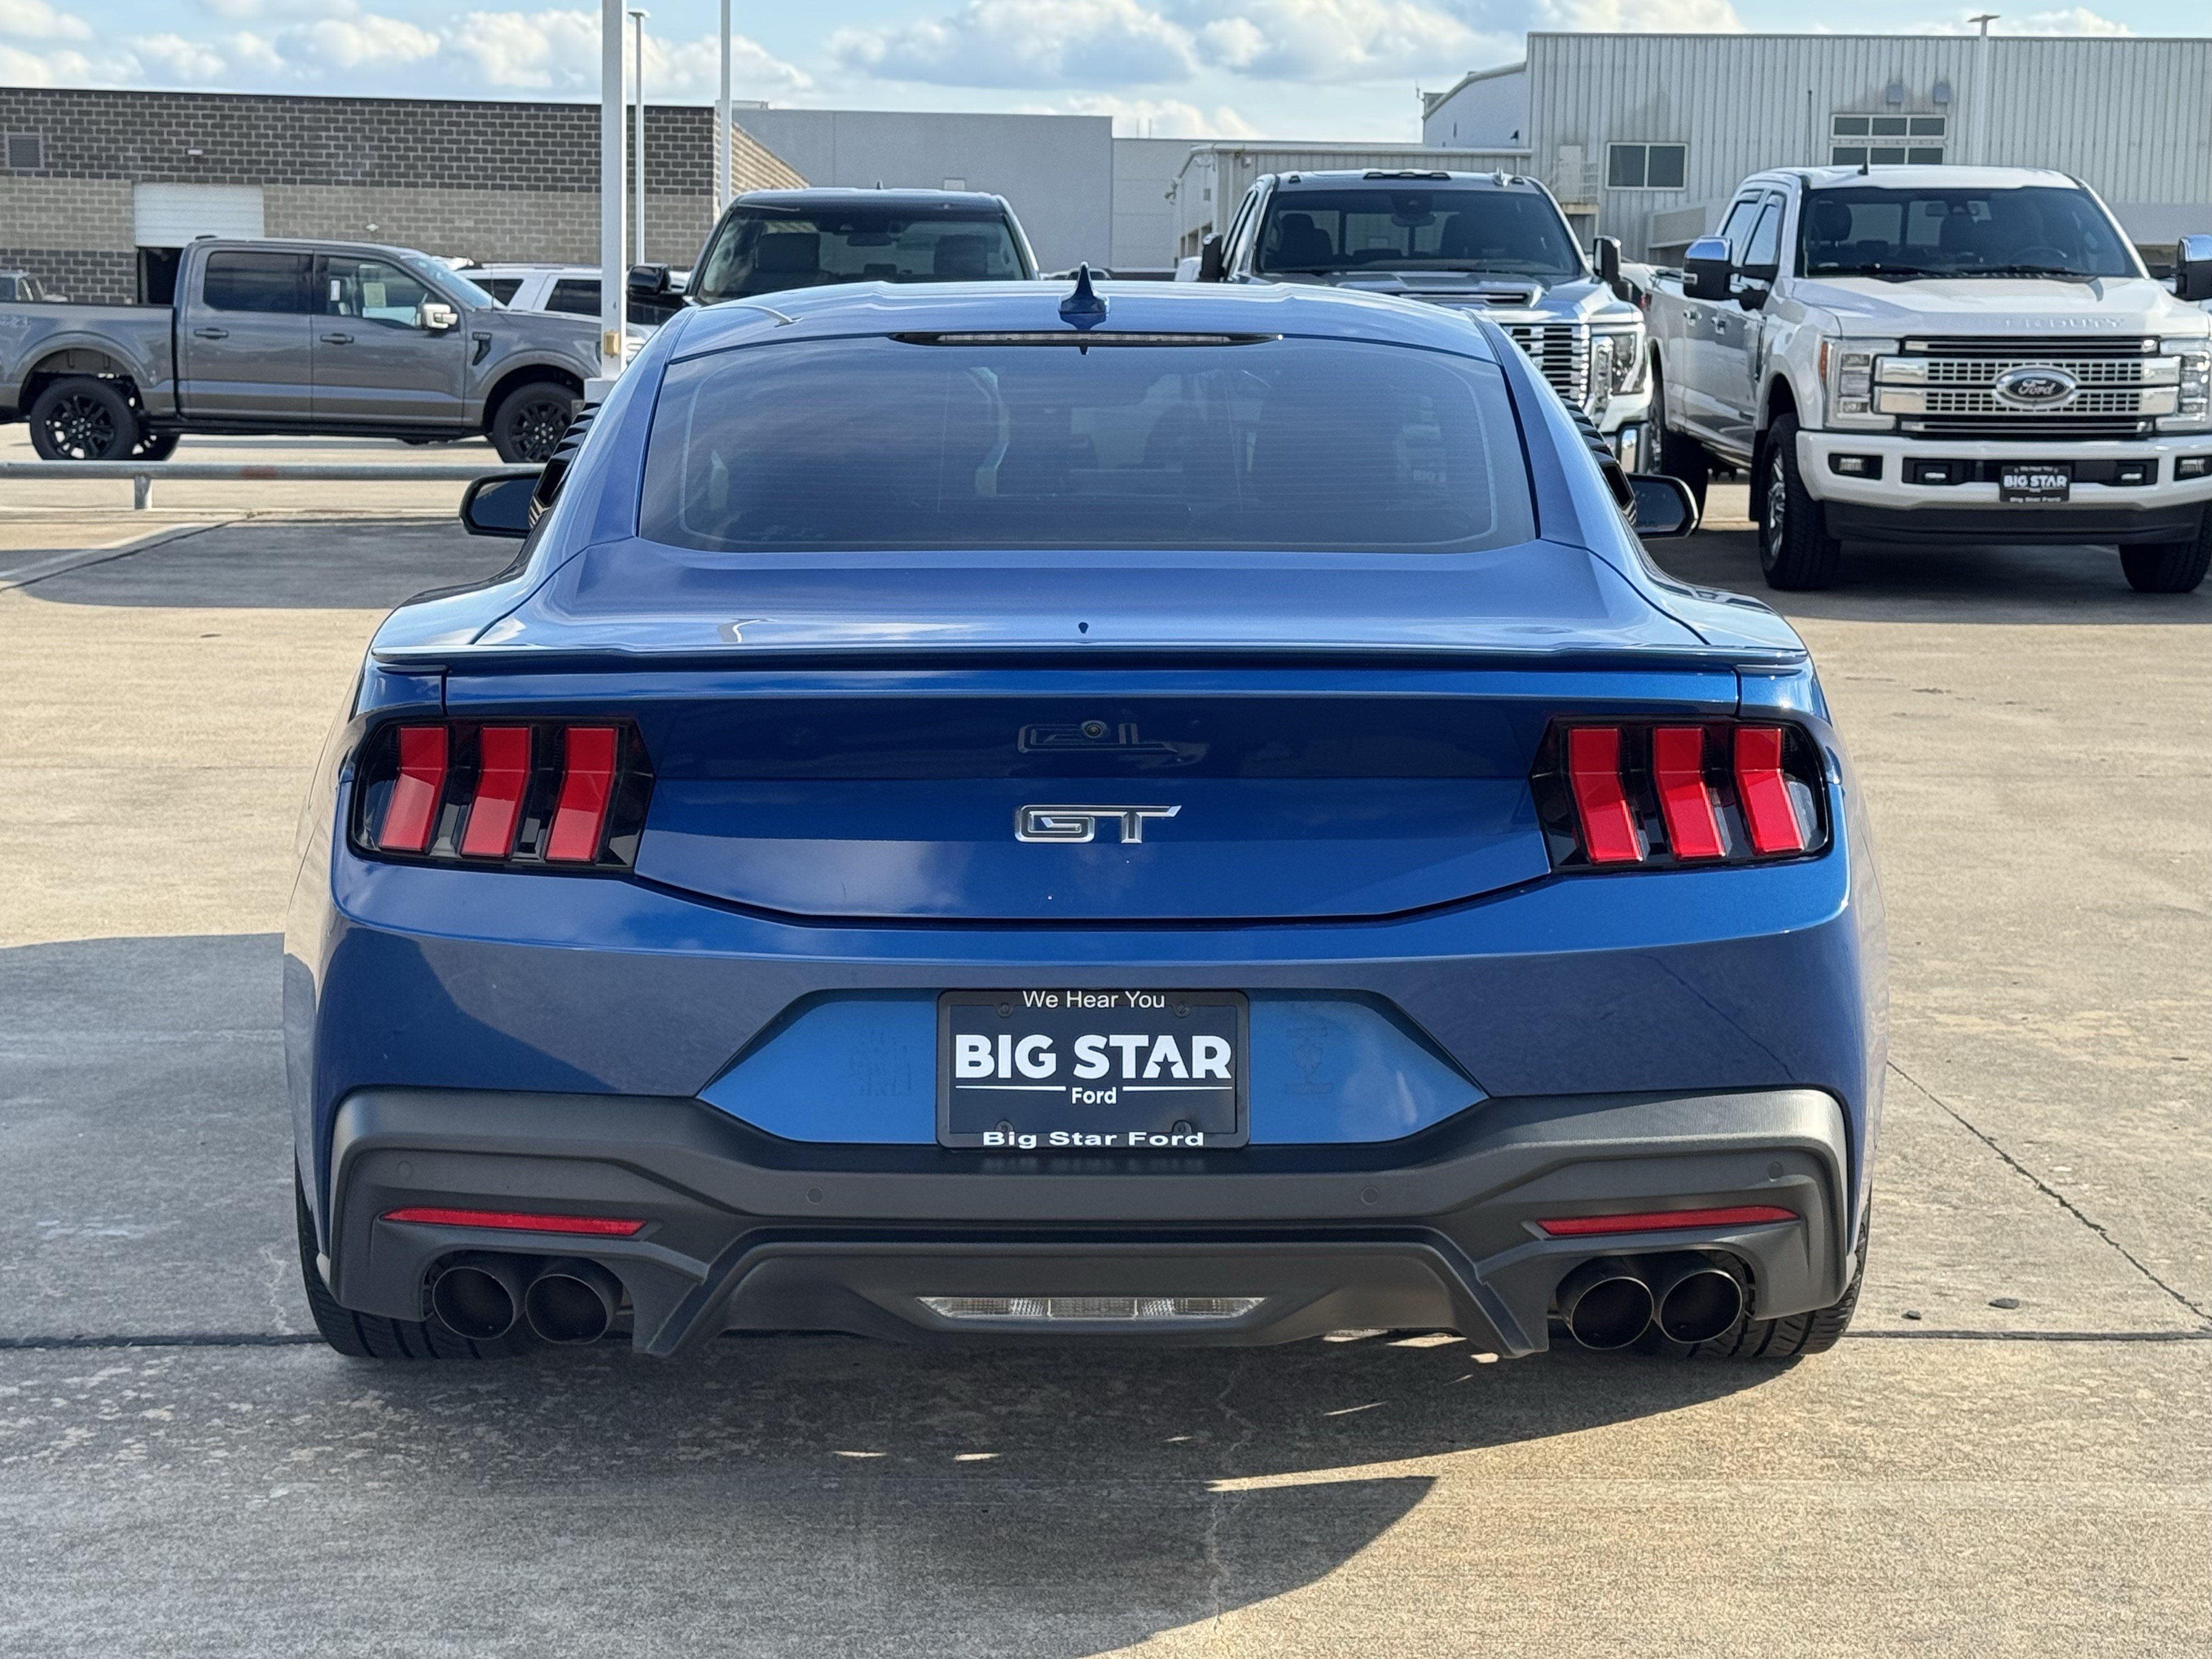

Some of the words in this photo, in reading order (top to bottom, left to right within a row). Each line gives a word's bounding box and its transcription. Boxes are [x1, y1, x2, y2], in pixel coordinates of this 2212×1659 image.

[2018, 379, 2056, 396] Ford
[2004, 475, 2029, 488] BIG
[2030, 475, 2068, 488] STAR
[1014, 804, 1182, 844] GT
[1023, 991, 1059, 1008] We
[1066, 991, 1119, 1008] Hear
[1124, 991, 1166, 1008] You
[955, 1034, 1057, 1079] BIG
[1073, 1034, 1232, 1079] STAR
[1071, 1087, 1117, 1104] Ford
[983, 1131, 1037, 1149] Big
[1049, 1131, 1117, 1147] Star
[1128, 1131, 1204, 1147] Ford
